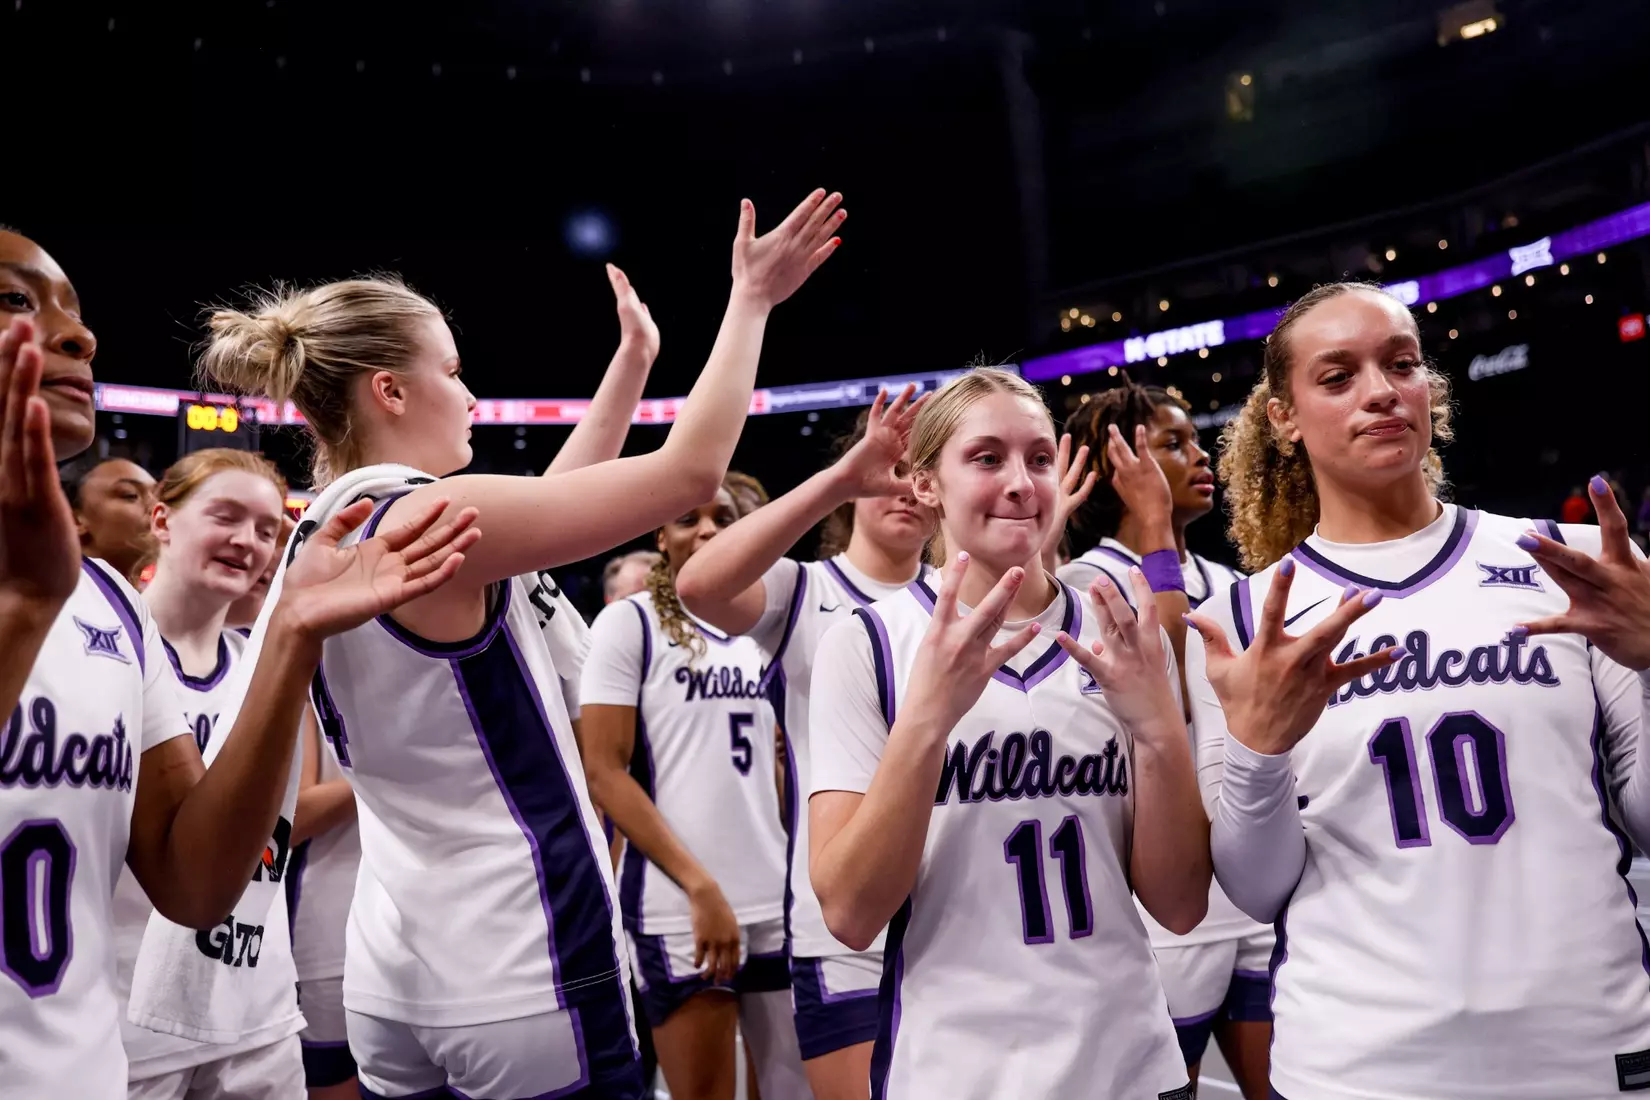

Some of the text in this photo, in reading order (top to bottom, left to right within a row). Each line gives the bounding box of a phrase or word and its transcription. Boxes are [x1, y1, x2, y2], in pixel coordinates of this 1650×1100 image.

[729, 712, 754, 777] 5
[934, 727, 1129, 806] Wildcats
[1369, 710, 1515, 848] 10
[1003, 815, 1093, 944] 11
